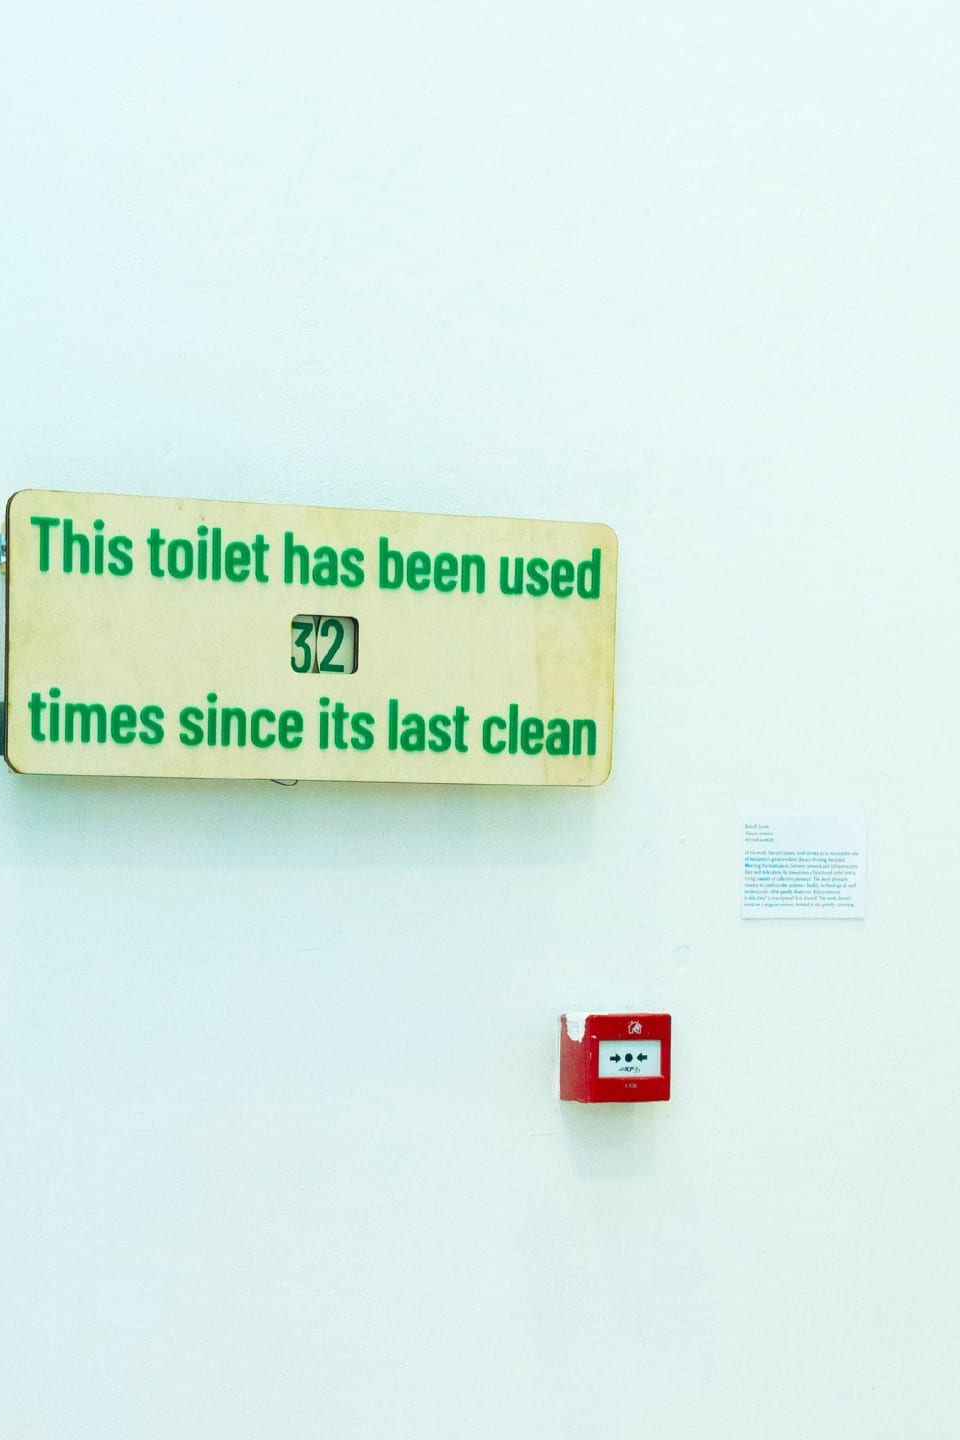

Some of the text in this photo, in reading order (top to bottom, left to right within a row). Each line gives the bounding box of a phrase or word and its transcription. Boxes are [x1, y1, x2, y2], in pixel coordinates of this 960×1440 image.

[30, 515, 602, 600] This toilet has been used
[290, 618, 345, 674] 32
[27, 686, 597, 757] times since its last clean
